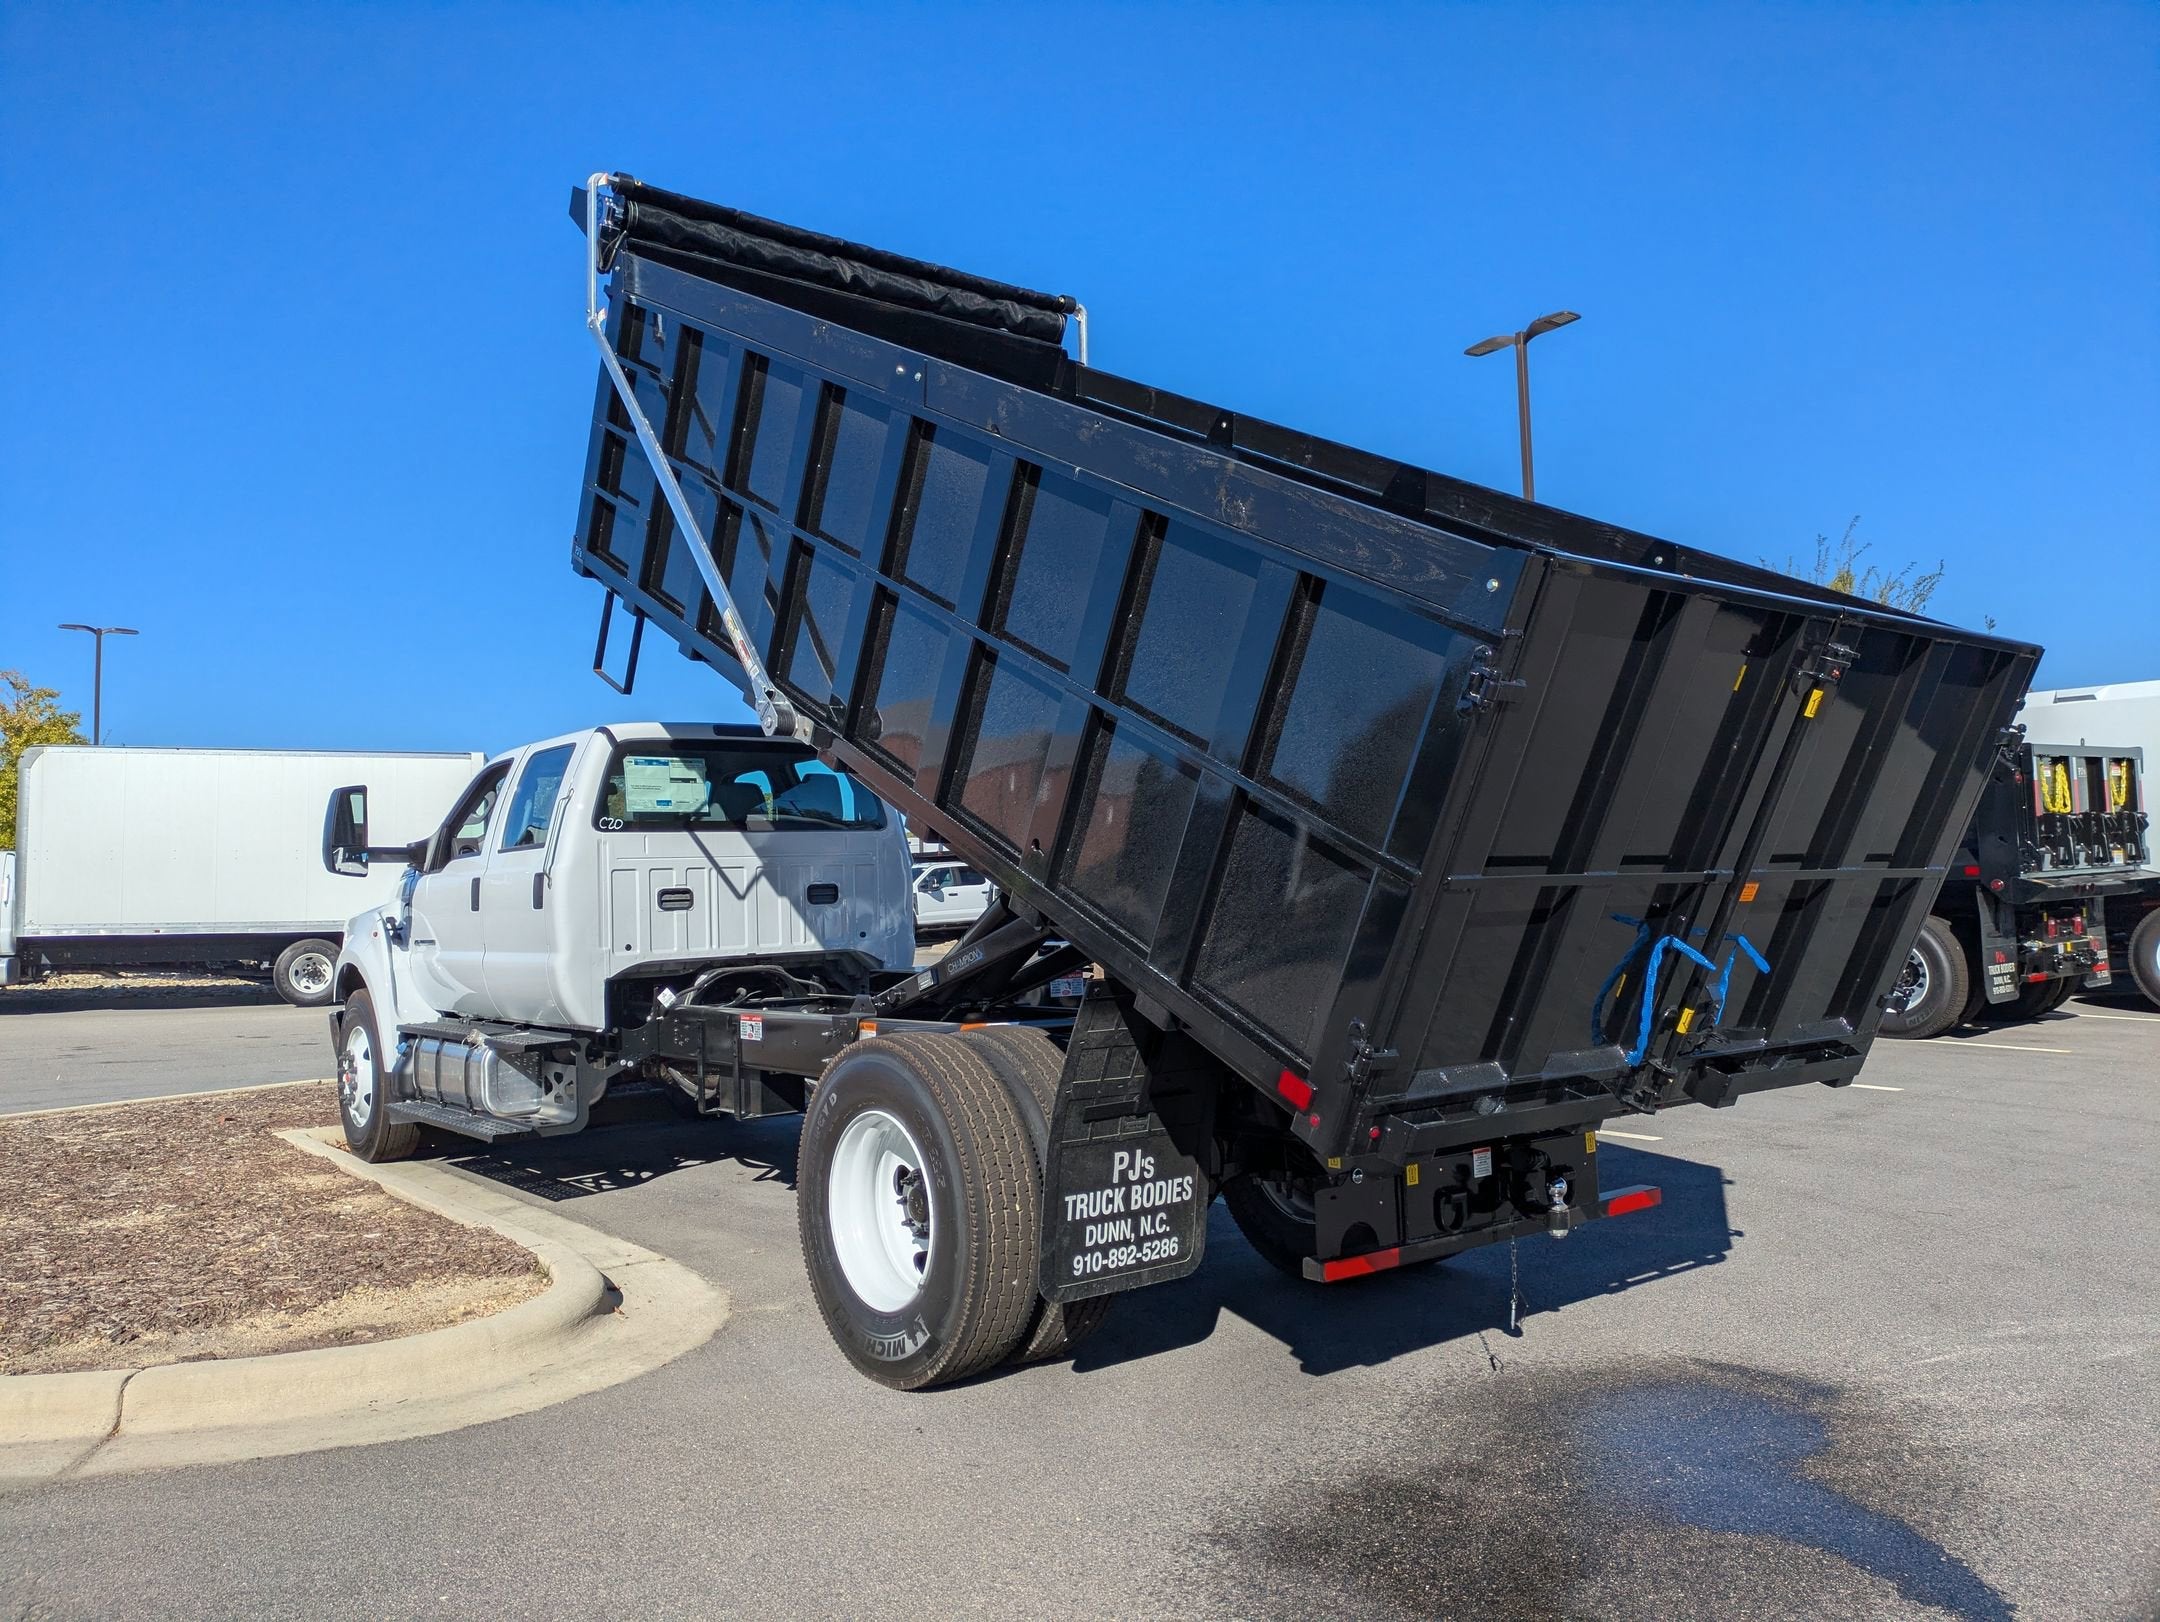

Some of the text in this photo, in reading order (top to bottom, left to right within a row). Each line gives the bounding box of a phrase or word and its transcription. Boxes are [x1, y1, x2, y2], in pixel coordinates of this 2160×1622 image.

[1064, 1175, 1193, 1222] TRUCK BODIES
[1085, 1212, 1170, 1247] DUNN, N.C.
[1073, 1237, 1179, 1276] 910-892-5286
